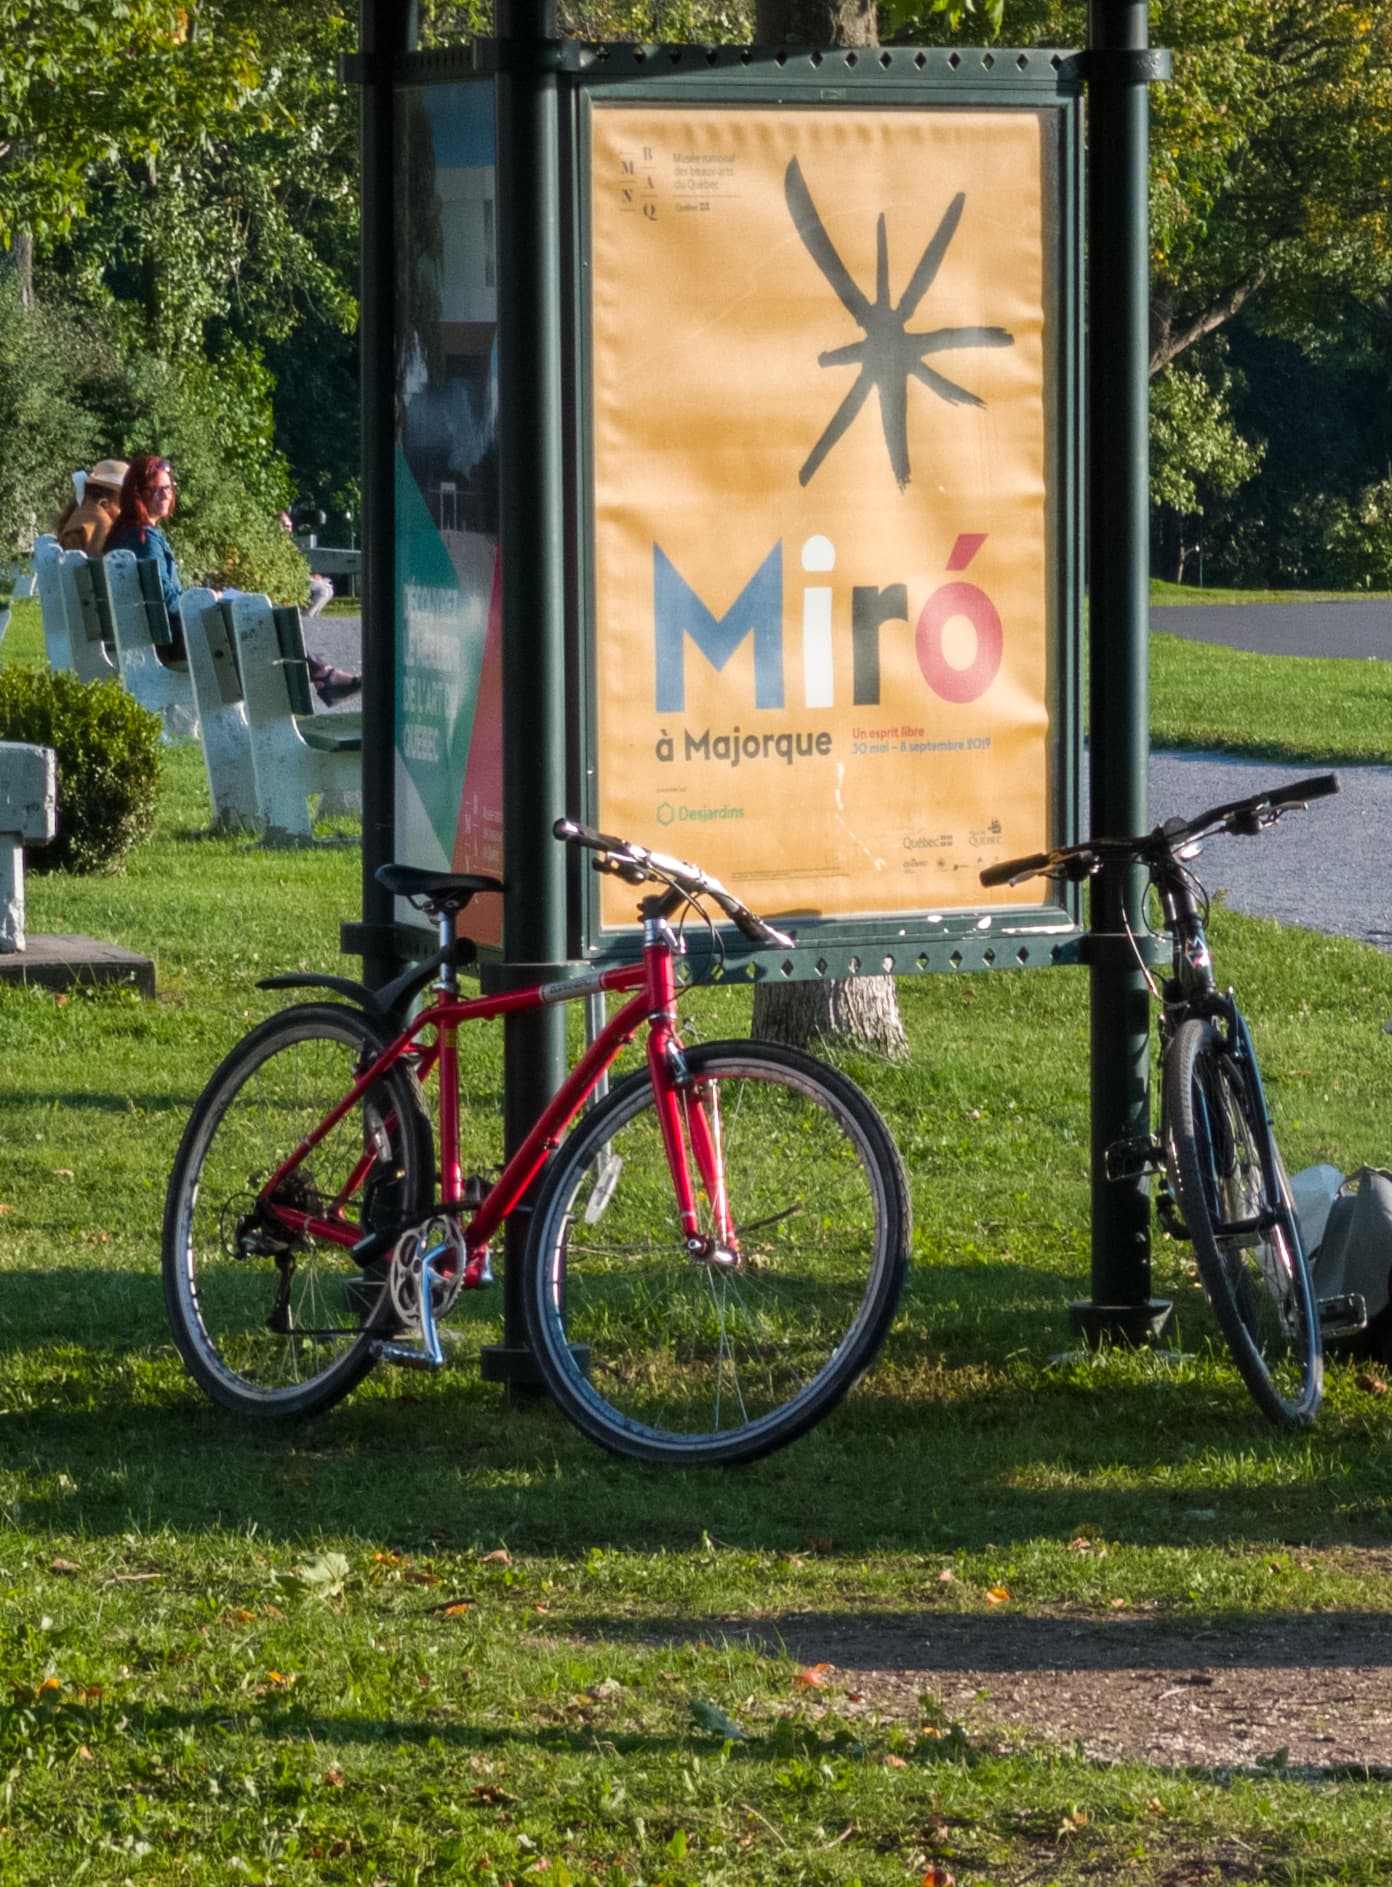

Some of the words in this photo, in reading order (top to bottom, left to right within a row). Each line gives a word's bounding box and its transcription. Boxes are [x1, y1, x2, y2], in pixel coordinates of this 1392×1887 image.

[621, 160, 634, 175] M
[643, 203, 658, 222] Q
[653, 533, 1004, 713] Miró
[852, 727, 867, 739] Un
[869, 725, 899, 741] esprit
[901, 725, 925, 737] libre
[655, 728, 674, 762] à
[684, 725, 833, 768] Majorque
[870, 742, 889, 754] mai
[909, 739, 964, 754] septembre
[679, 803, 745, 822] Desjardins
[903, 836, 940, 850] Québec
